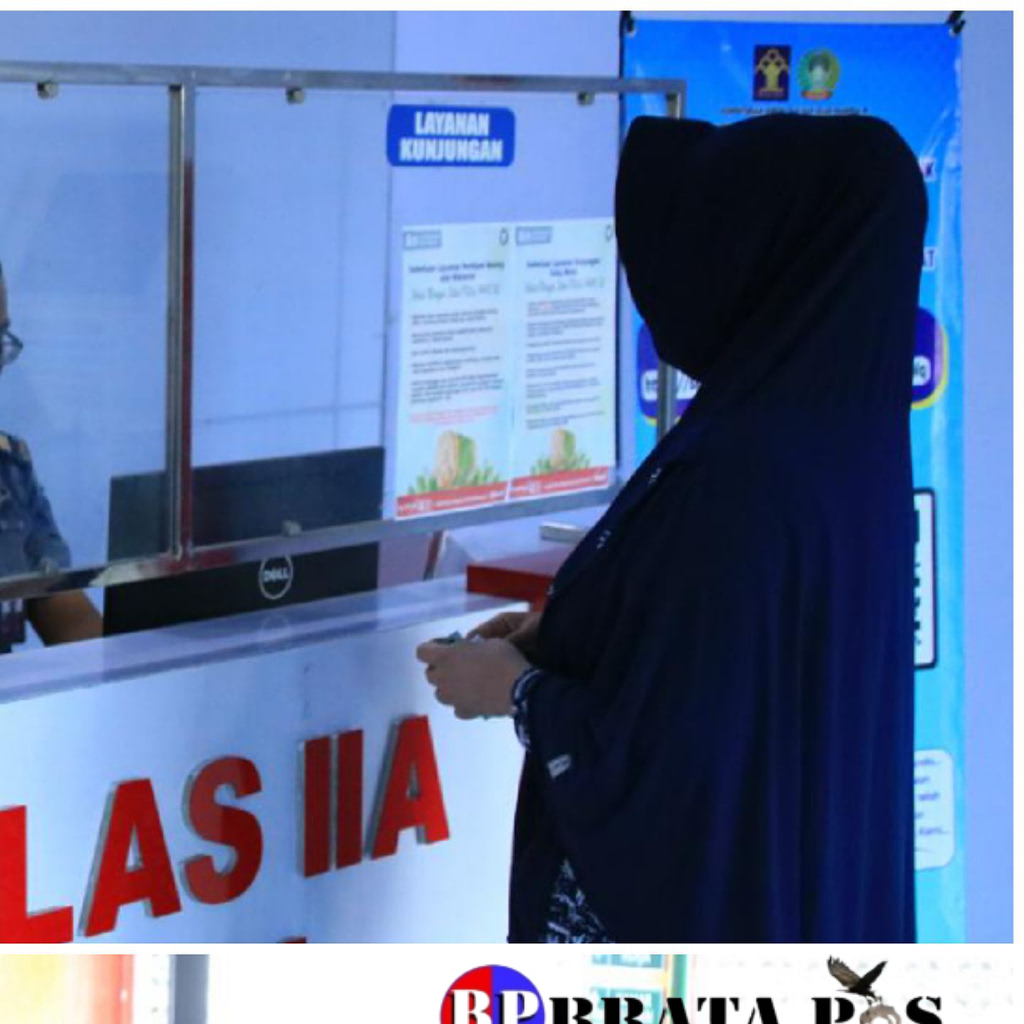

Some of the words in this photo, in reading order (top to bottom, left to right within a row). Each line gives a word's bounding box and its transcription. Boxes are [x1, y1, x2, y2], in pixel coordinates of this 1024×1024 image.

[414, 111, 490, 136] LAYANAN
[399, 137, 503, 162] KUNJUNGAN
[297, 714, 451, 877] IIA
